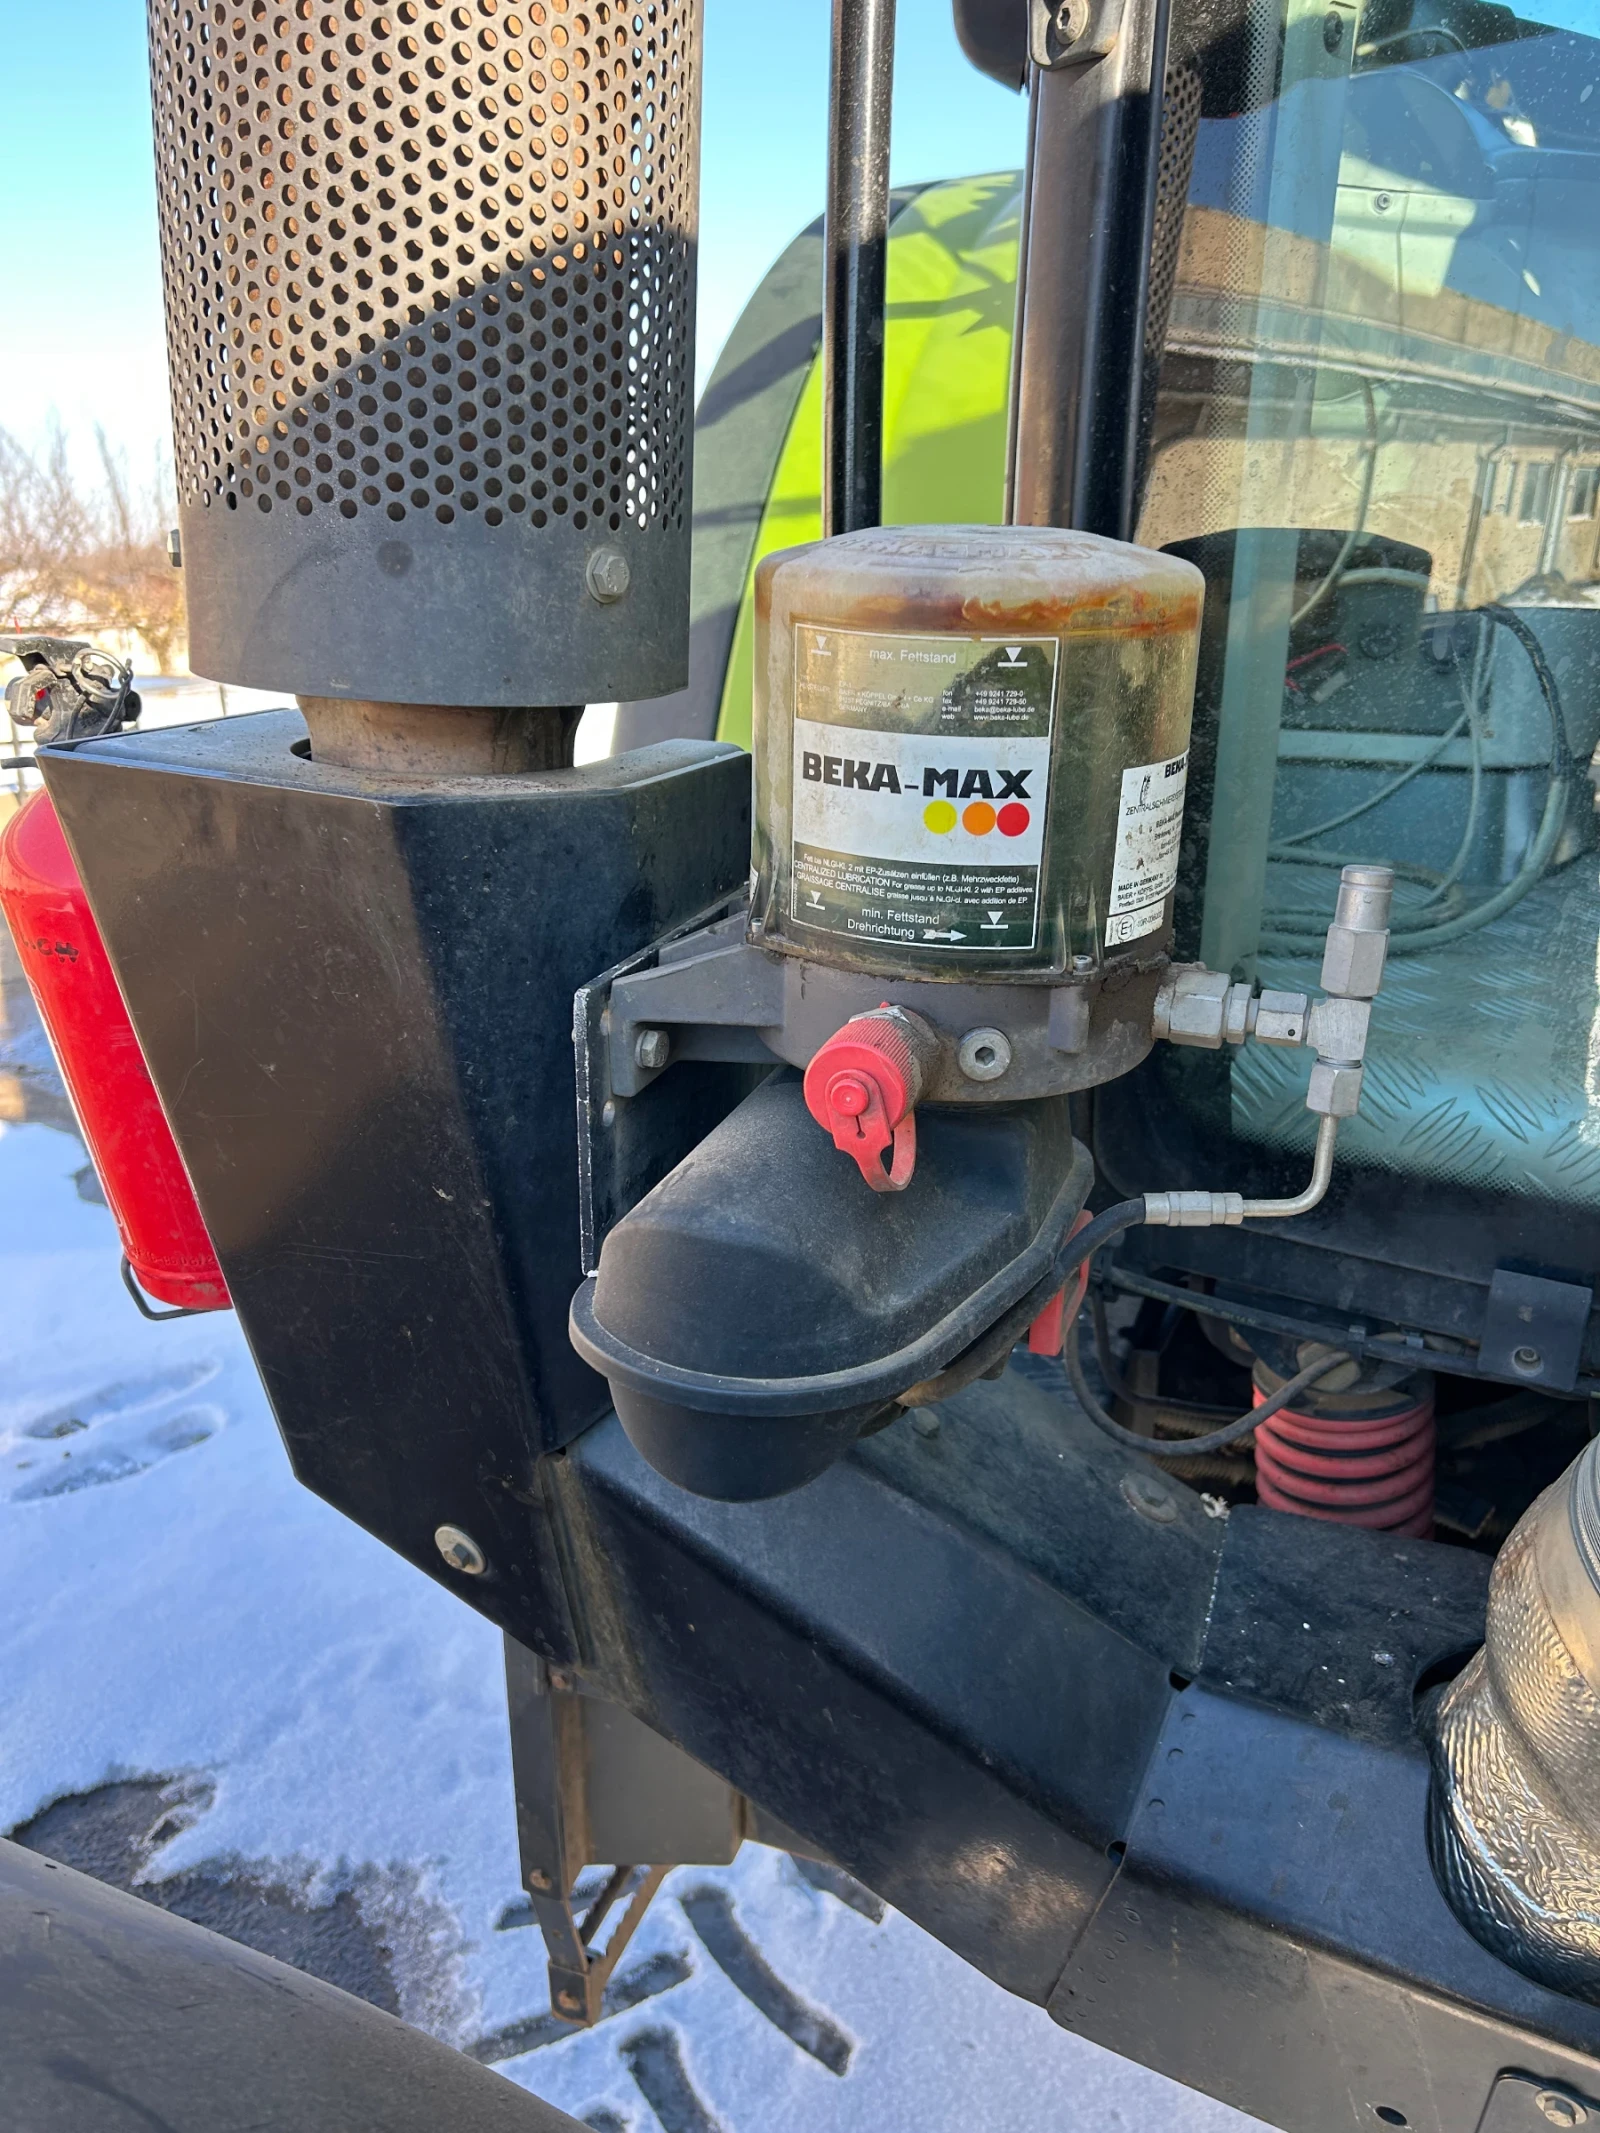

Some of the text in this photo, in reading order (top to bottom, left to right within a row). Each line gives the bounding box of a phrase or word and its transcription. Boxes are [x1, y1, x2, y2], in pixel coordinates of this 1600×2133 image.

[869, 649, 957, 664] max. Fettstand
[923, 696, 934, 704] KG
[803, 751, 1034, 799] BEKA-MAX
[794, 860, 836, 878] CENTRALIZED
[837, 870, 890, 887] LUBRICATION
[891, 881, 903, 889] For
[903, 883, 926, 892] grease
[926, 885, 936, 893] up
[814, 856, 822, 864] bis
[854, 865, 864, 873] mit
[865, 866, 909, 879] EP-Zusätzen
[911, 872, 940, 881] einfüllen
[942, 874, 958, 883] (z.B.
[796, 871, 834, 889] GRAISSAGE
[835, 881, 885, 897] CENTRALISE
[886, 892, 909, 900] graisse
[1118, 883, 1133, 892] MADE
[861, 907, 940, 925] min. Fettstand
[847, 918, 915, 939] Drehrichtung
